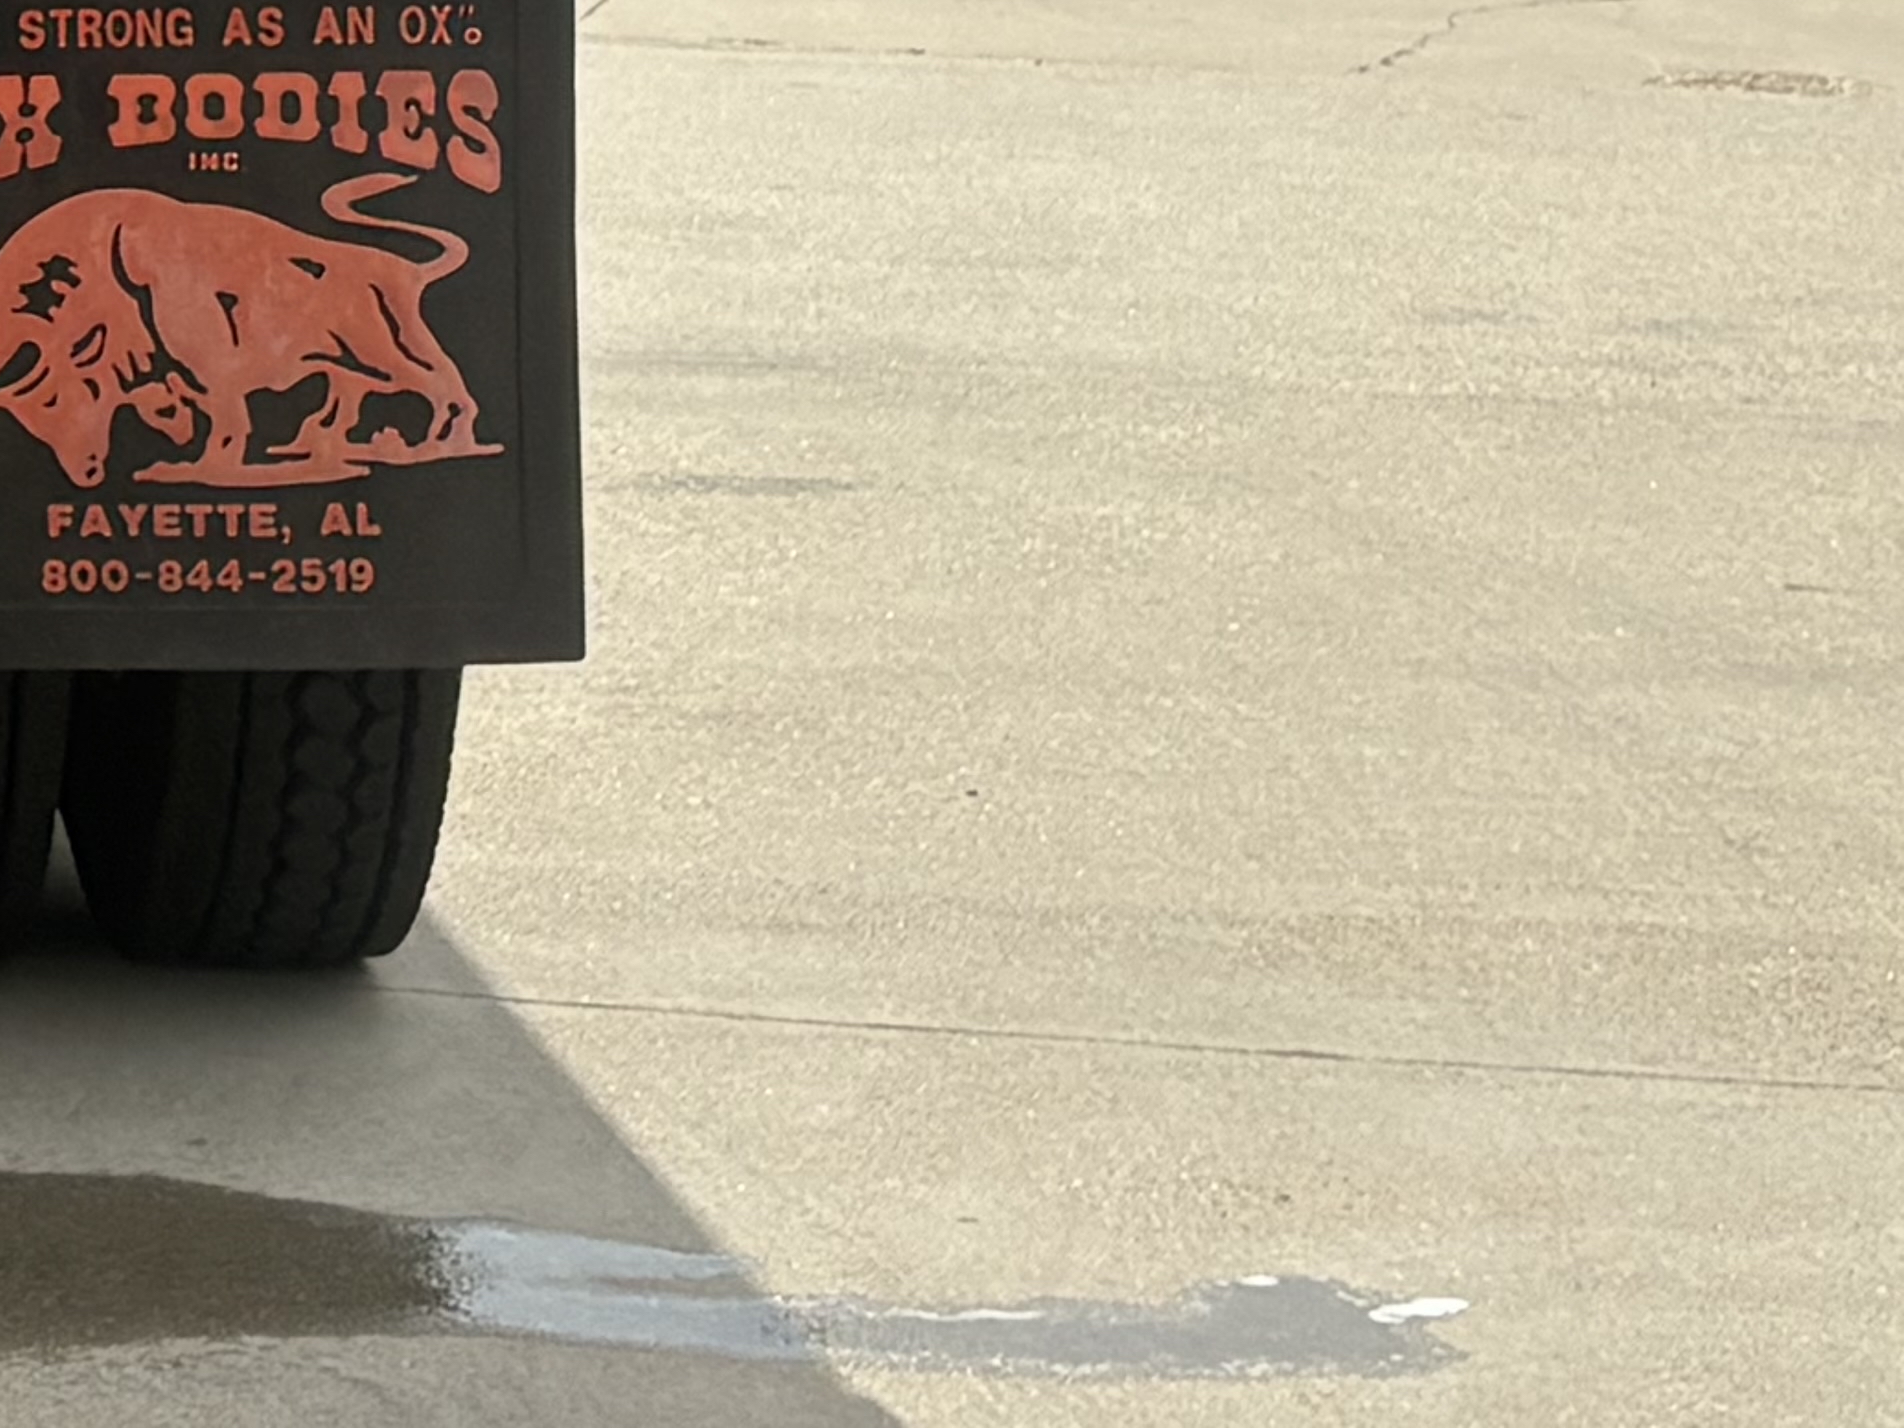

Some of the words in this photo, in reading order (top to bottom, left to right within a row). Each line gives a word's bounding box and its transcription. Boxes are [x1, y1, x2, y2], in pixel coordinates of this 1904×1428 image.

[18, 6, 197, 52] STRONG
[222, 6, 288, 49] AS
[313, 5, 377, 47] AN
[105, 69, 503, 195] BODIES
[188, 151, 241, 174] INC
[45, 502, 295, 545] FAYETTE,
[319, 501, 383, 538] AL
[41, 557, 377, 595] 800-844-2519
